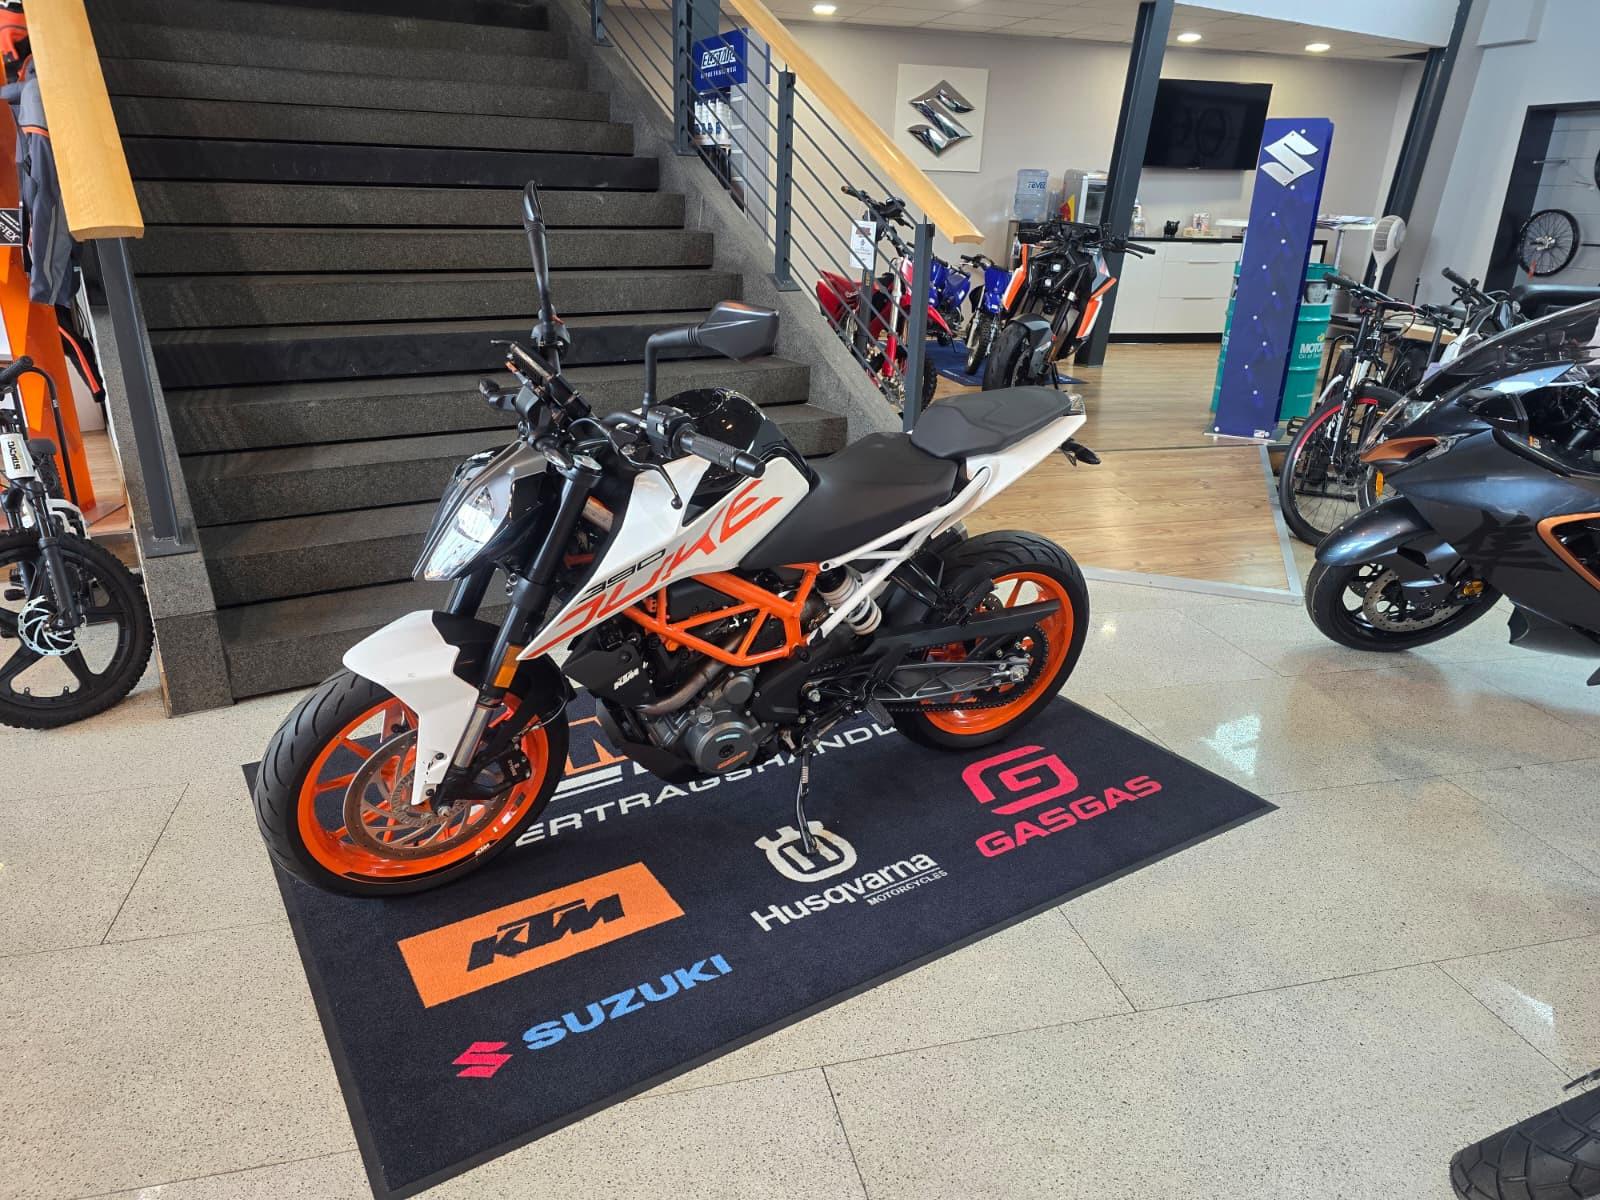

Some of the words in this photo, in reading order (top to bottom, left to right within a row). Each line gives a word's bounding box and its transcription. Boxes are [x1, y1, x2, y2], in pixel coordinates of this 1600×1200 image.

[525, 480, 784, 659] DUKE
[576, 549, 666, 605] 390
[976, 775, 1162, 857] GASGAS
[750, 853, 938, 932] Husqvarna
[867, 869, 948, 907] MOTORCYCLES
[466, 893, 625, 972] KTM
[521, 953, 733, 1051] SUZUKI
